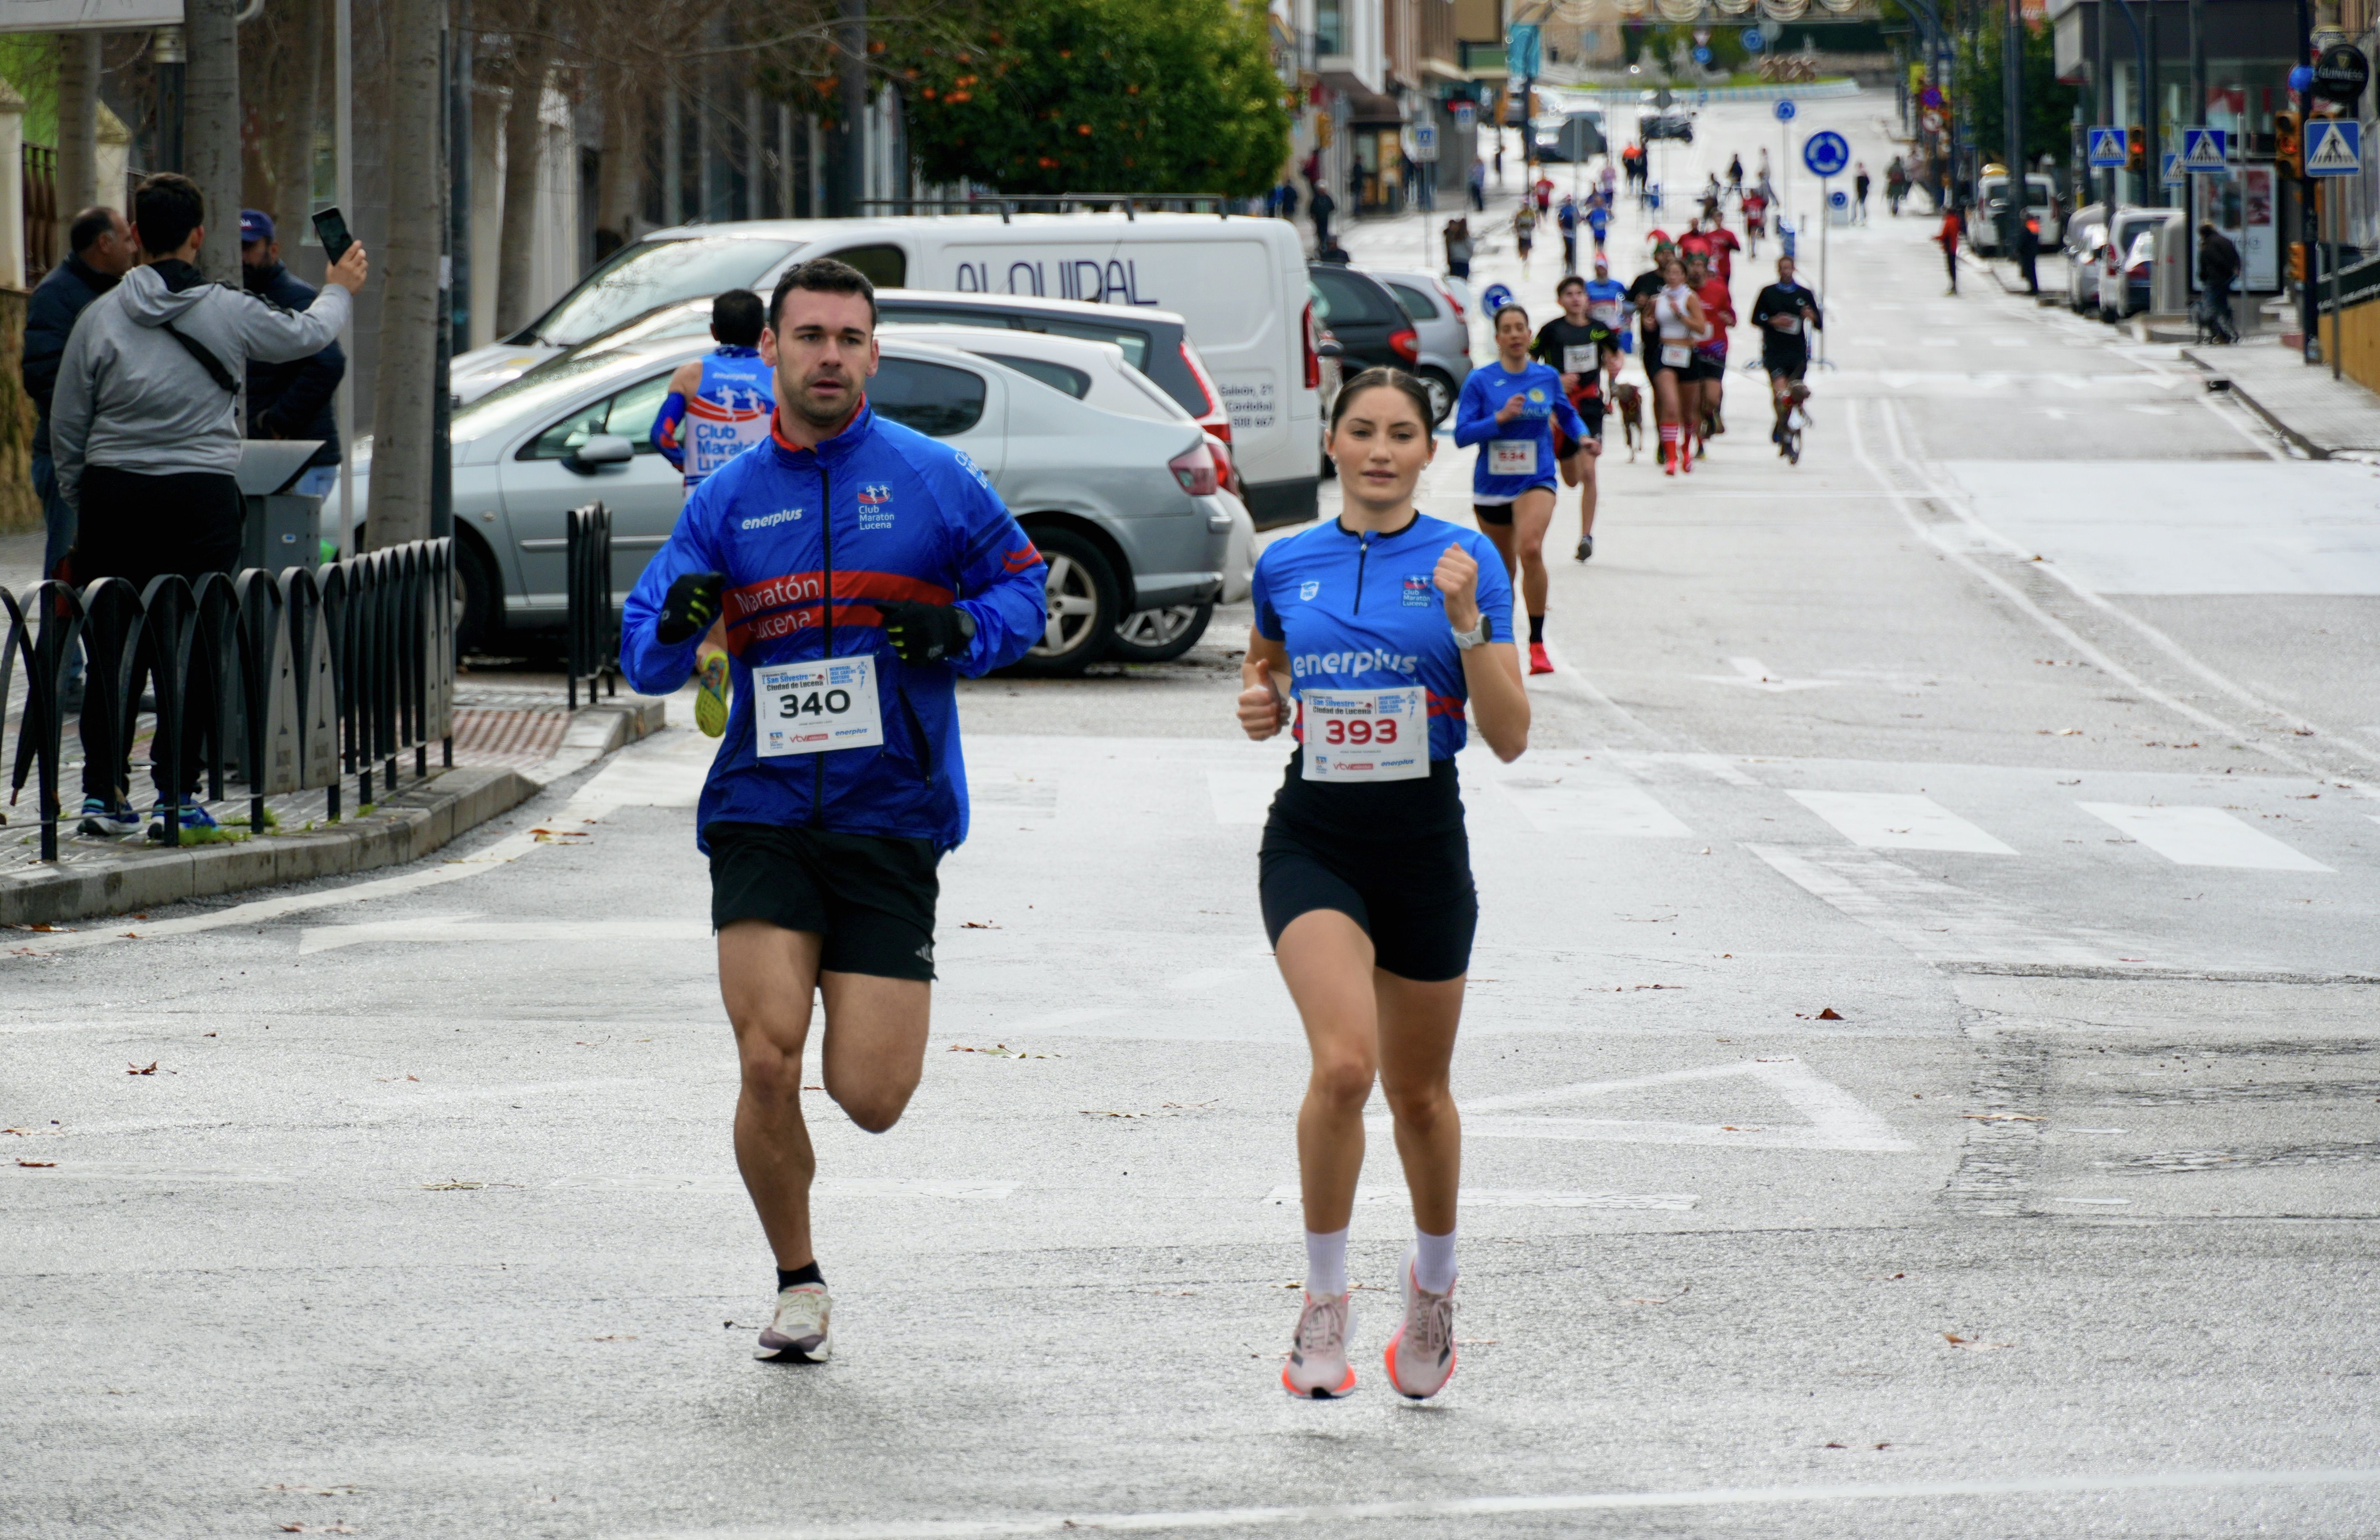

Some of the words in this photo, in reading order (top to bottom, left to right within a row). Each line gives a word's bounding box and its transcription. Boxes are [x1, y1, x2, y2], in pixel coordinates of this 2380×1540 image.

[696, 424, 735, 439] Club
[697, 440, 755, 456] Marat
[698, 457, 727, 471] Luc
[859, 505, 880, 514] Club
[741, 508, 803, 530] enerplus
[859, 513, 895, 522] Maratón
[859, 521, 892, 530] Lucena
[734, 575, 820, 614] Maratón
[1294, 648, 1417, 678] enerplus
[780, 674, 809, 683] Silvestre
[767, 683, 790, 691] Ciudad
[800, 680, 824, 688] Lucena
[780, 689, 851, 719] 340
[1345, 707, 1371, 715] Lucena
[835, 728, 868, 736] enerplus
[1326, 719, 1397, 745] 393
[1381, 759, 1415, 767] enerplus
